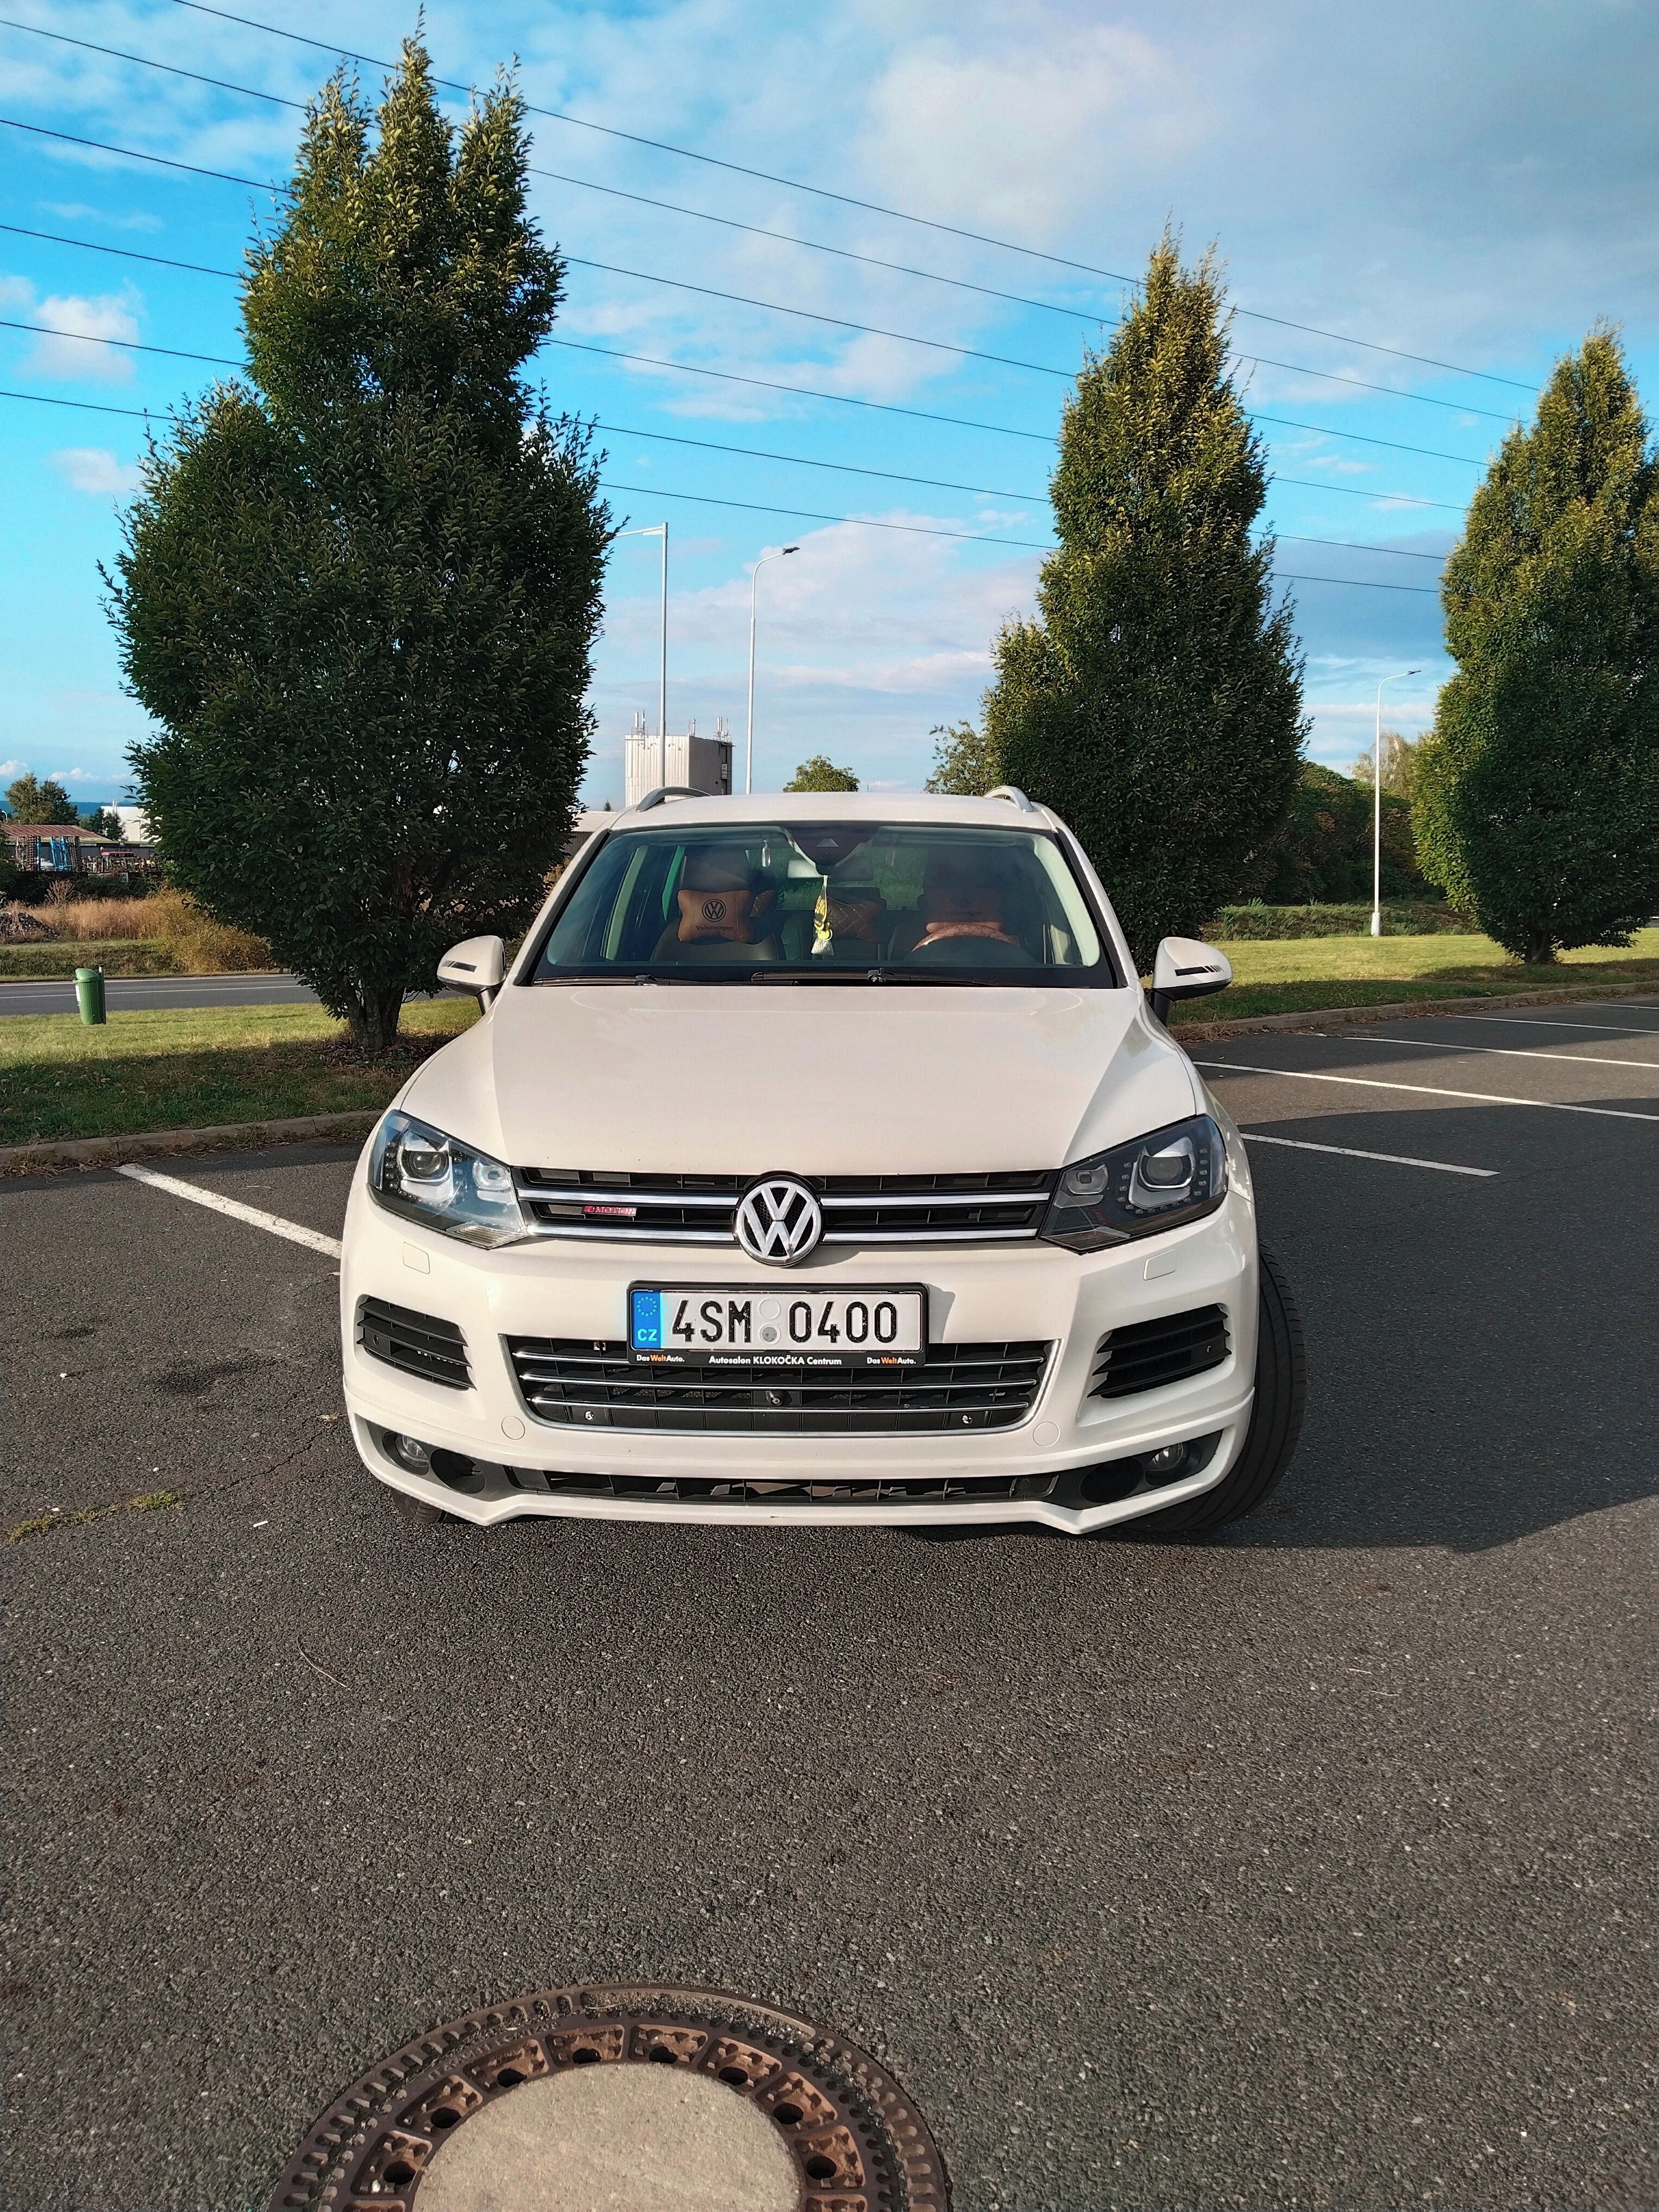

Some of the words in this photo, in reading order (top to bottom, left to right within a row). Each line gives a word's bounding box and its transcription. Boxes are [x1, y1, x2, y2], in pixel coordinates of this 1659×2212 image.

[672, 1299, 751, 1343] 4SM
[789, 1301, 897, 1344] 0400
[637, 1328, 658, 1342] CZ
[709, 1355, 751, 1364] Autosalon
[753, 1355, 805, 1365] KLOKOČKA
[807, 1356, 842, 1365] Centrum
